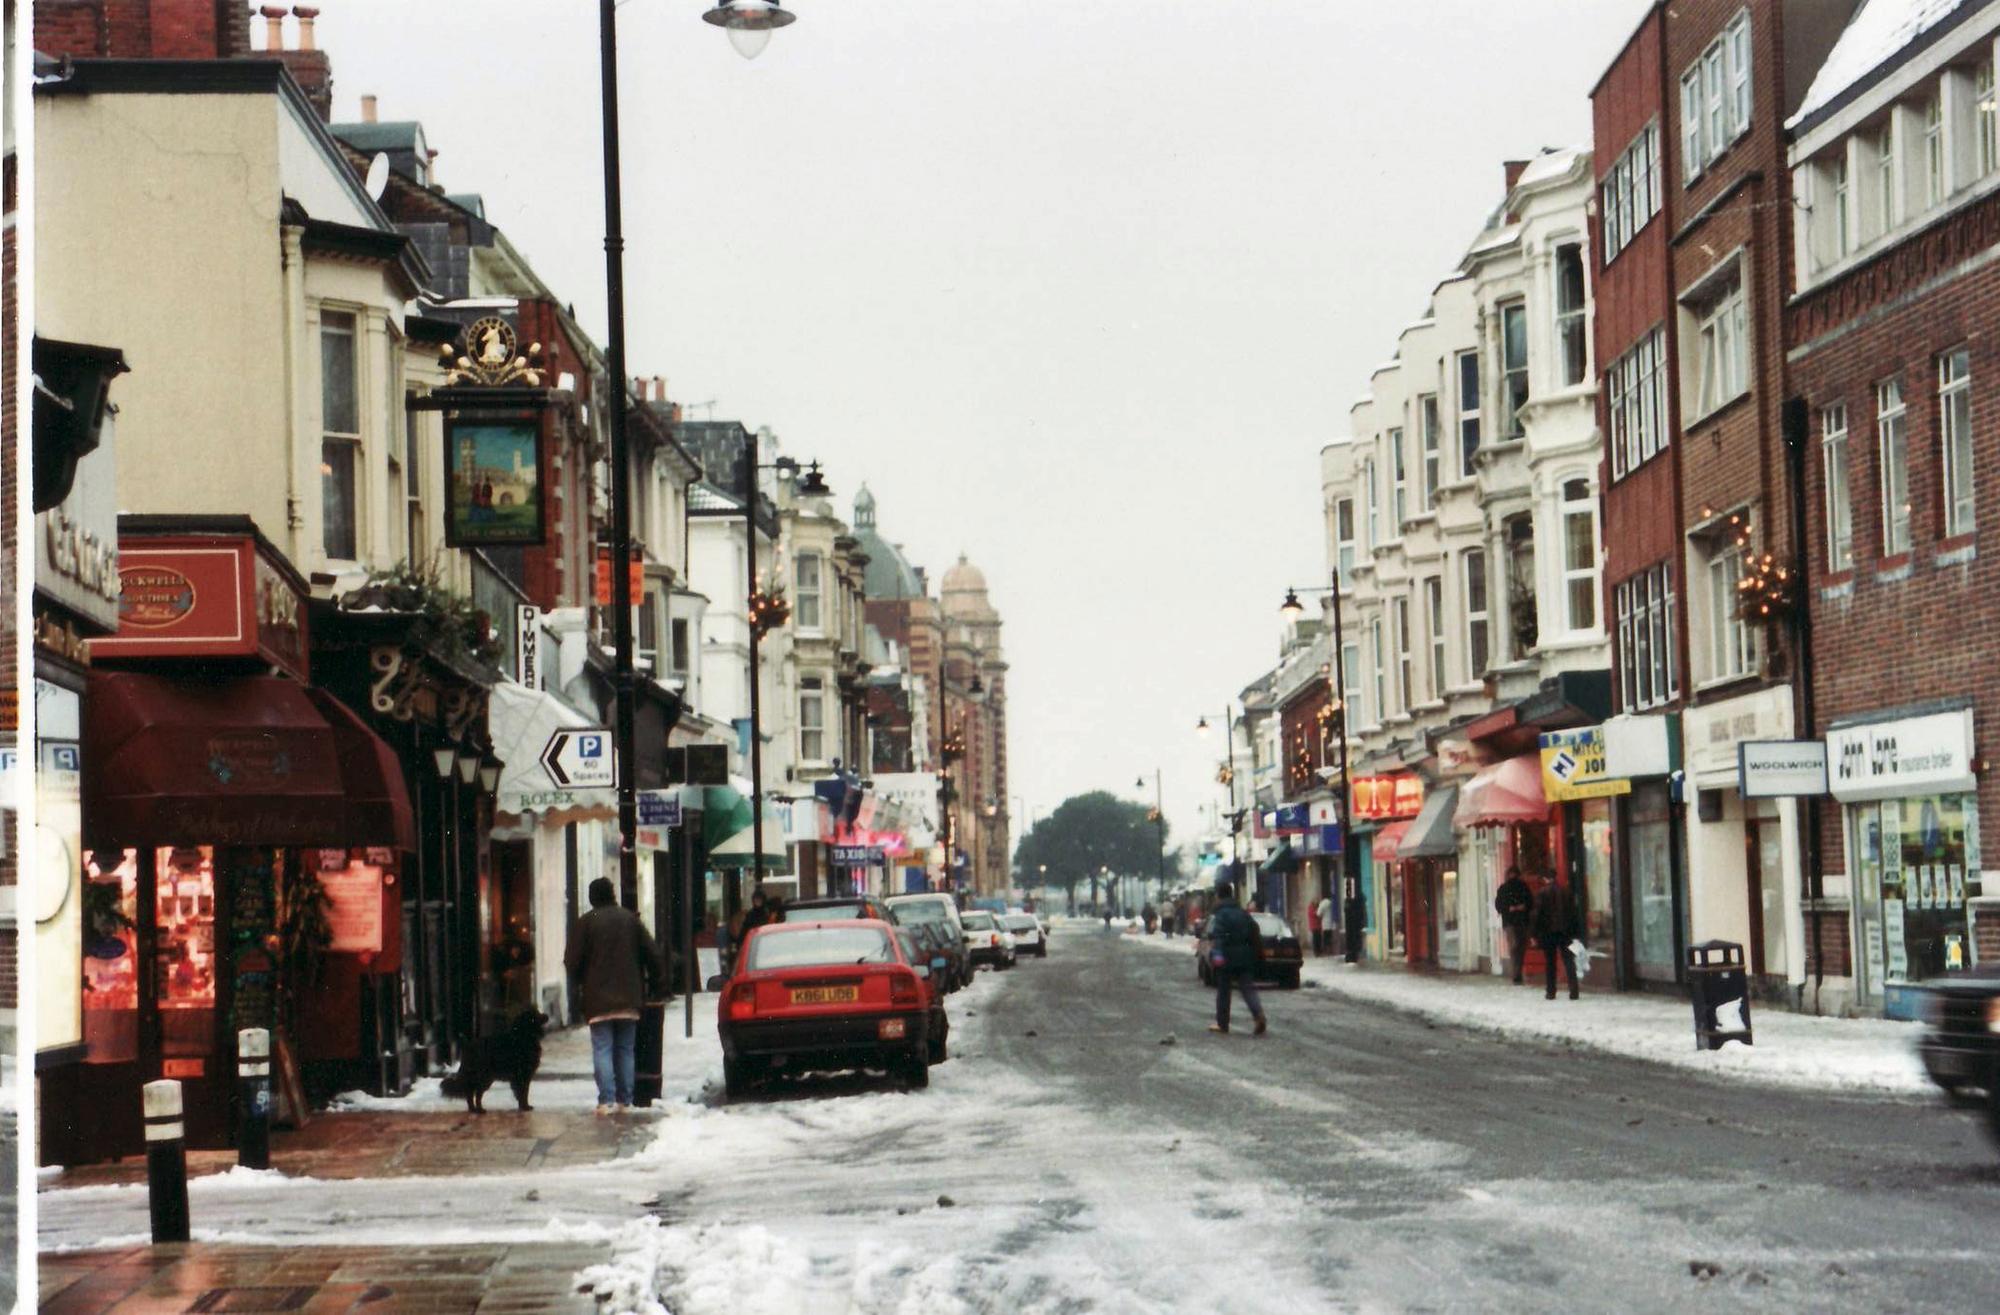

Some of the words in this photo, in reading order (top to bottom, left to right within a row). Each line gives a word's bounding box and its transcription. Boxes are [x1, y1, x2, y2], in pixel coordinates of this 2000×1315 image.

[1749, 761, 1823, 770] WOOLWICH
[573, 771, 610, 781] Spaces
[520, 791, 574, 807] ROLEX
